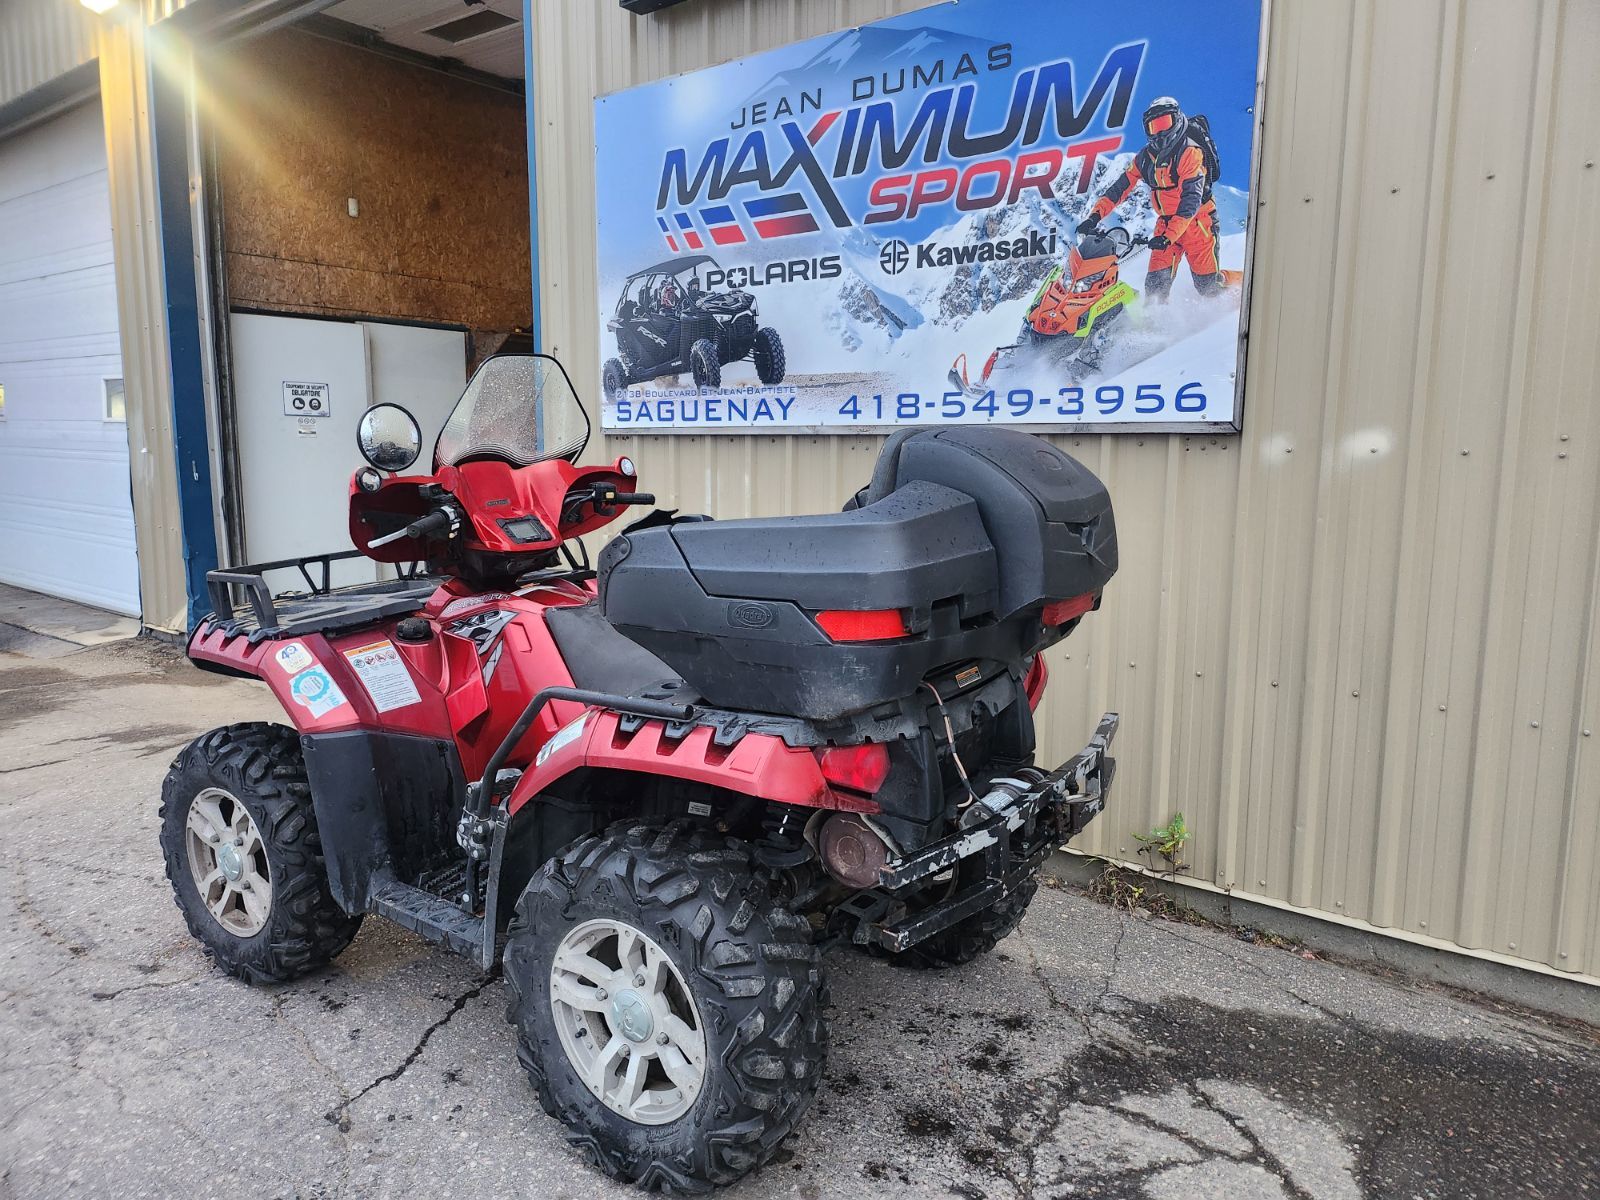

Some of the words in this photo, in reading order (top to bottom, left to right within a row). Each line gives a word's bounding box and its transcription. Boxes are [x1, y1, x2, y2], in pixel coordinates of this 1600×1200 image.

[731, 88, 821, 130] JEAN
[853, 43, 1012, 101] DUMAS
[656, 42, 1146, 228] MAXIMUM
[863, 136, 1122, 224] SPORT
[916, 228, 1056, 268] Kawasaki
[706, 255, 842, 291] POLARIS
[616, 396, 796, 422] SAGUENAY
[838, 382, 1207, 420] 418-549-3956
